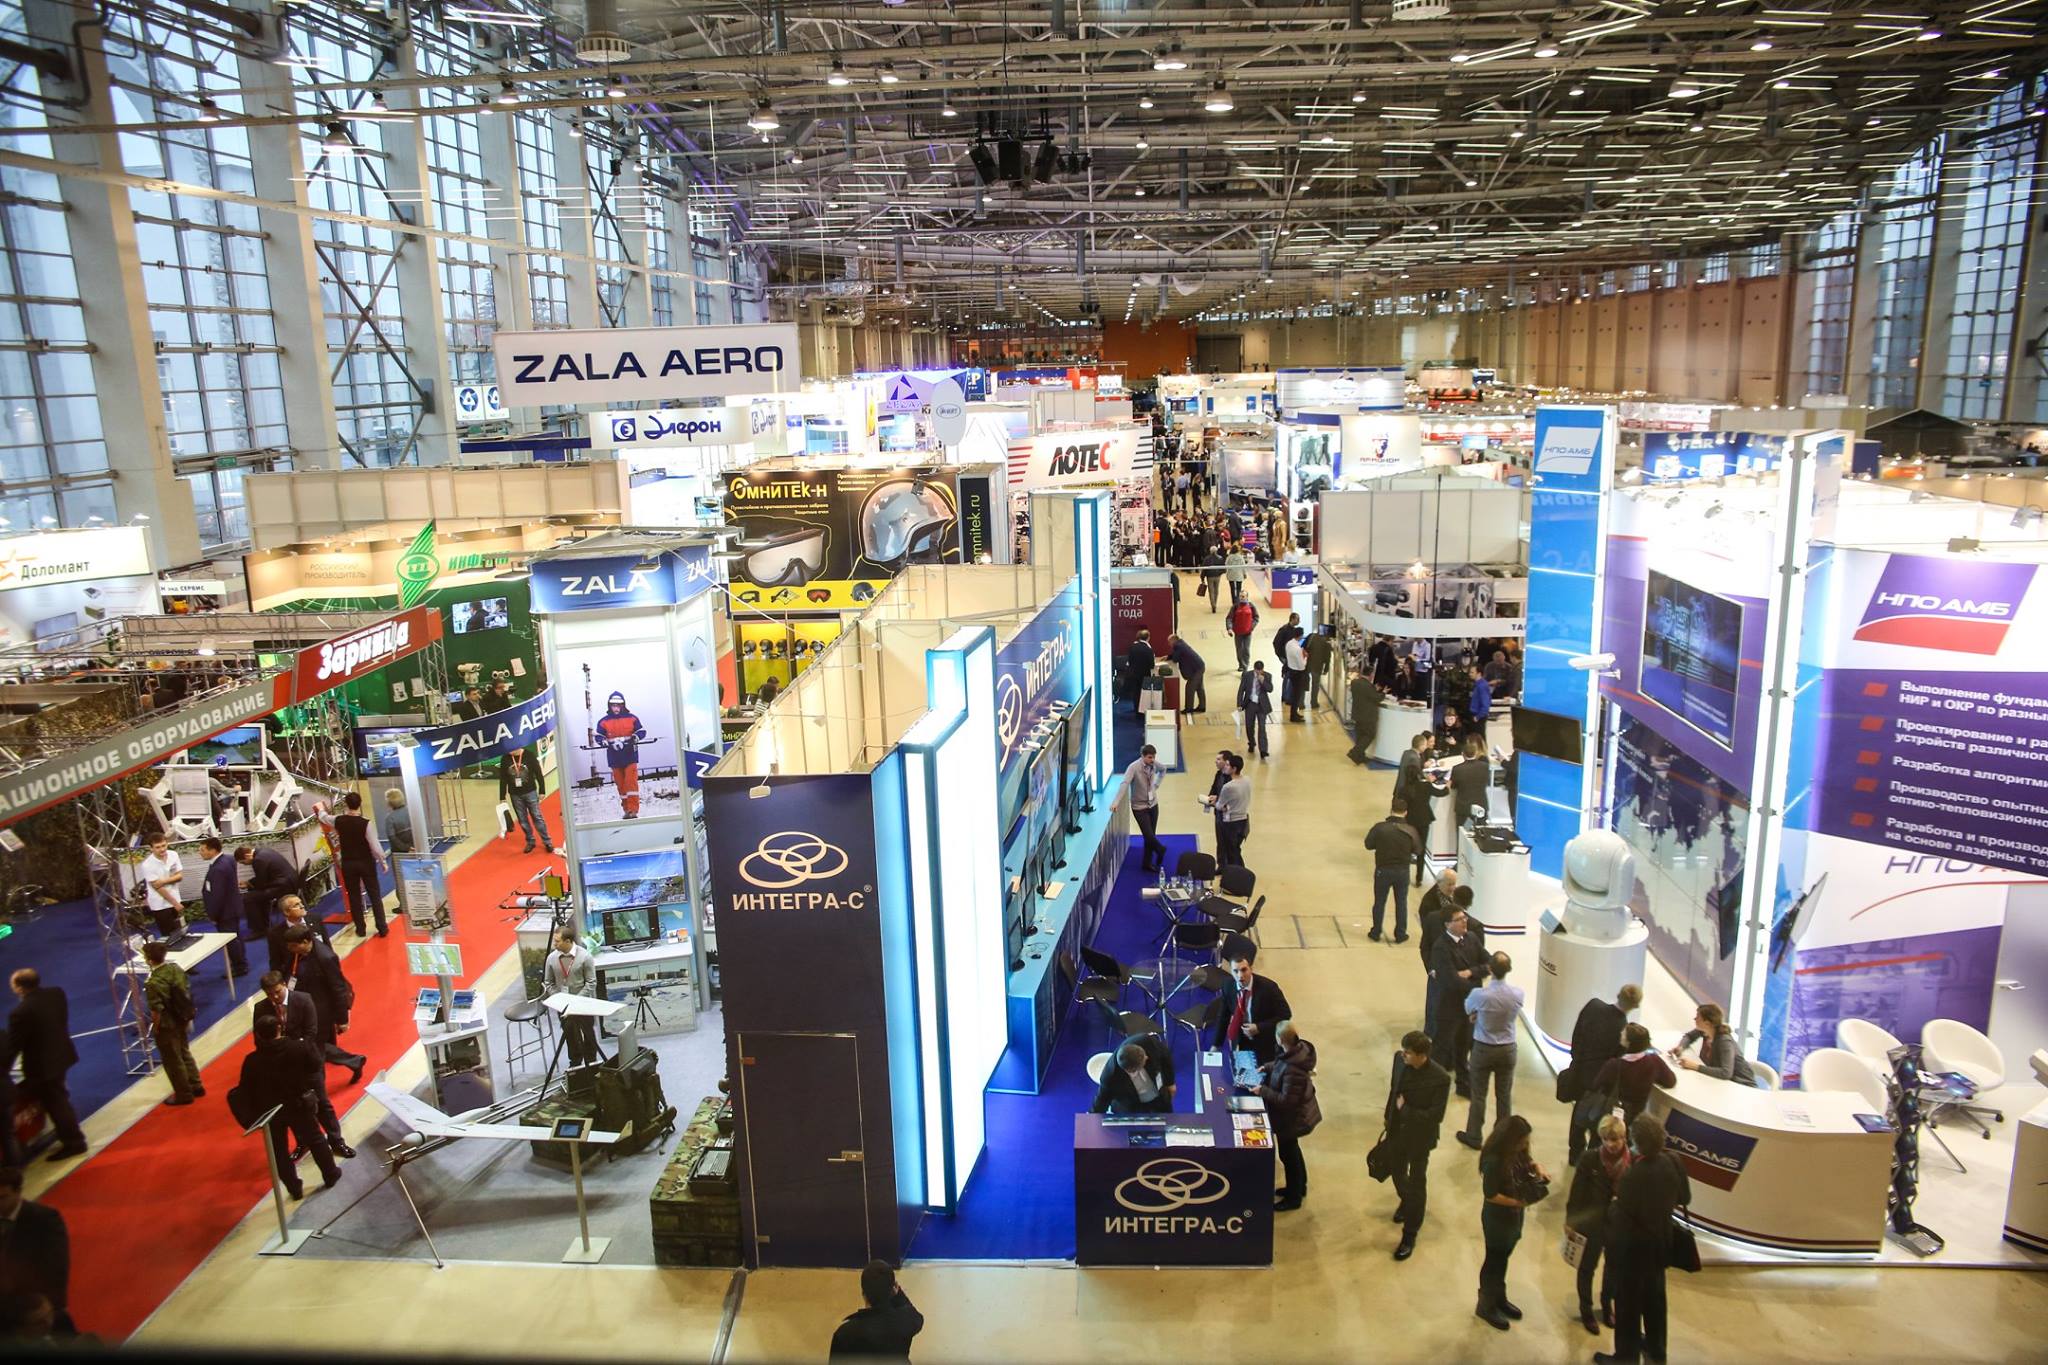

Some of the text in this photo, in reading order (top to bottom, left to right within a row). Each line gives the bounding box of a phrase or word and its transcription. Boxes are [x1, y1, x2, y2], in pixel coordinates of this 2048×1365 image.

[513, 346, 784, 384] ZALA AERO
[643, 415, 721, 442] Элерон
[966, 494, 982, 565] omnitek.ru
[21, 561, 91, 581] Доломант
[561, 573, 650, 596] ZALA
[1112, 594, 1143, 606] с 1875
[1877, 592, 2011, 617] НПО АМБ
[1118, 609, 1143, 620] года
[317, 621, 409, 680] Зарница
[1900, 680, 1990, 702] Выполнение
[1899, 694, 2048, 722] НИР и ОКР по разны
[127, 692, 267, 760] ОБОРУДОВАНИЕ
[431, 698, 556, 761] ZALA AERO
[1896, 717, 2013, 745] Проектирование
[2016, 735, 2027, 746] и
[1894, 731, 1966, 751] устройств
[1892, 756, 1970, 777] Разработка
[1890, 780, 1989, 805] Производство
[1886, 816, 1963, 840] Разработка
[1966, 831, 1976, 842] и
[1885, 830, 1901, 842] на
[1904, 834, 1953, 852] основе
[1955, 843, 2027, 865] лазерных
[2029, 856, 2048, 870] те
[732, 891, 865, 911] ИНТЕГРА-С
[1699, 1149, 1740, 1169] АМБ
[1104, 1216, 1244, 1234] ИНТЕГРА-С
